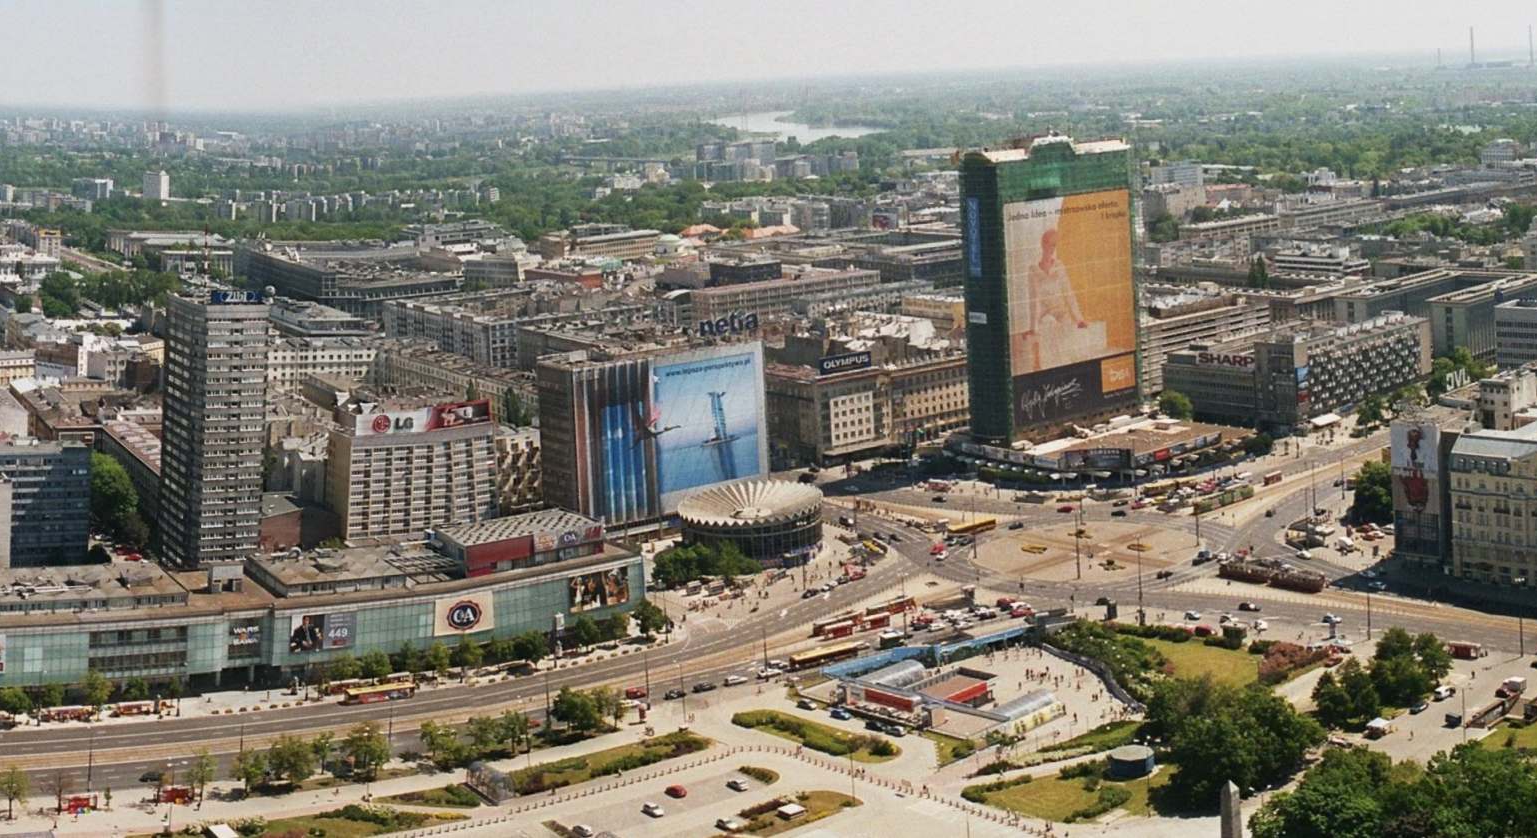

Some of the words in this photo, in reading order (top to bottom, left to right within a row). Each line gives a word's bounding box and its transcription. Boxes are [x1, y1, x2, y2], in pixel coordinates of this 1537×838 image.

[699, 311, 759, 337] netia
[823, 354, 869, 369] OLYMPUS
[1198, 352, 1255, 367] SHARP
[394, 416, 413, 430] LG
[328, 627, 348, 639] 449
